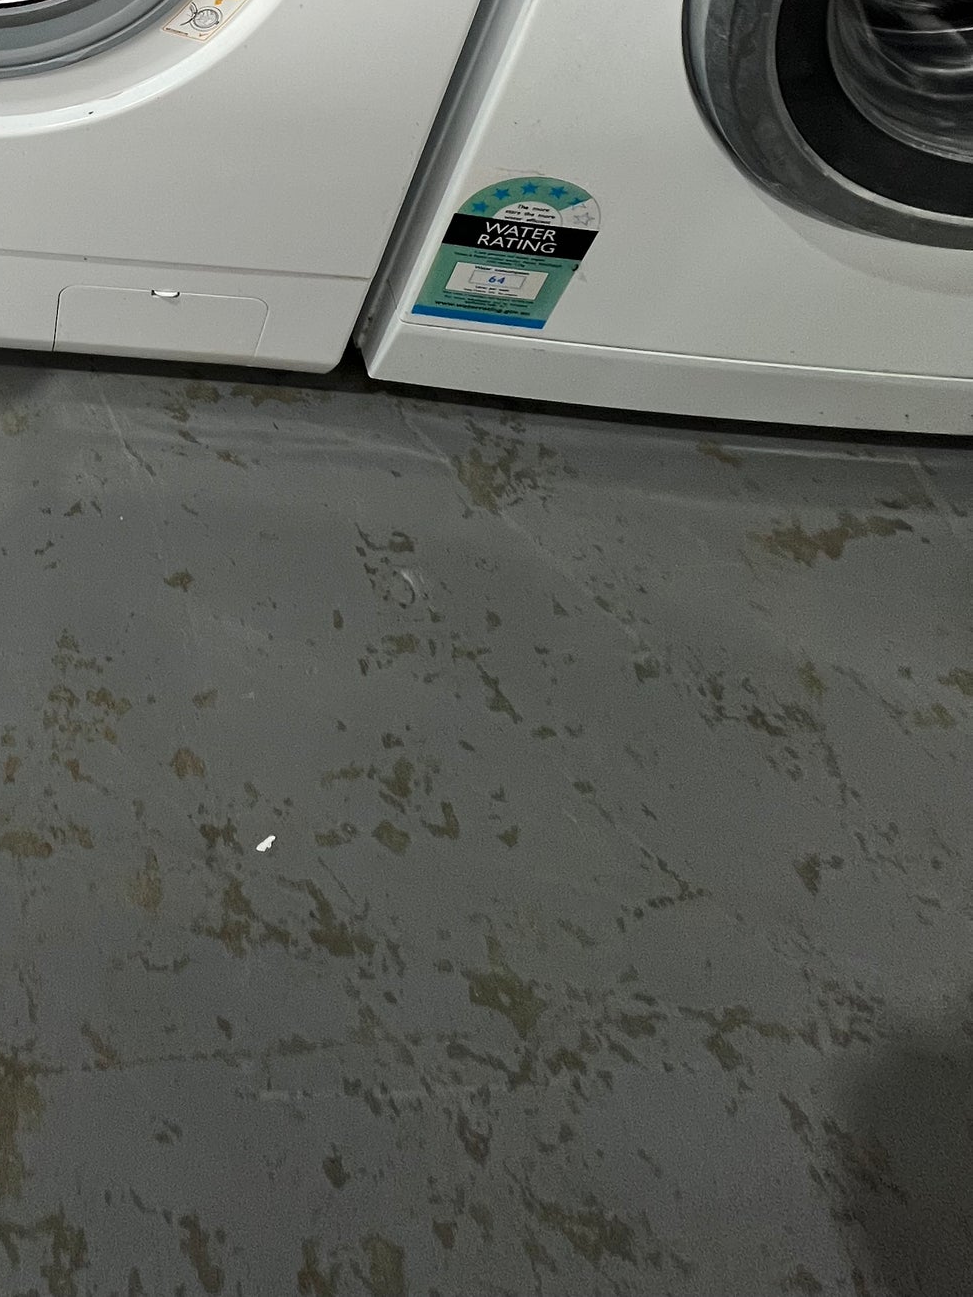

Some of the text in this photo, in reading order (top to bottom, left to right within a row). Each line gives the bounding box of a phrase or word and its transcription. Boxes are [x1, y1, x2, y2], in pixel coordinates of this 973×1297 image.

[486, 222, 556, 242] WATER
[477, 233, 558, 254] RATING
[488, 275, 506, 284] 64
